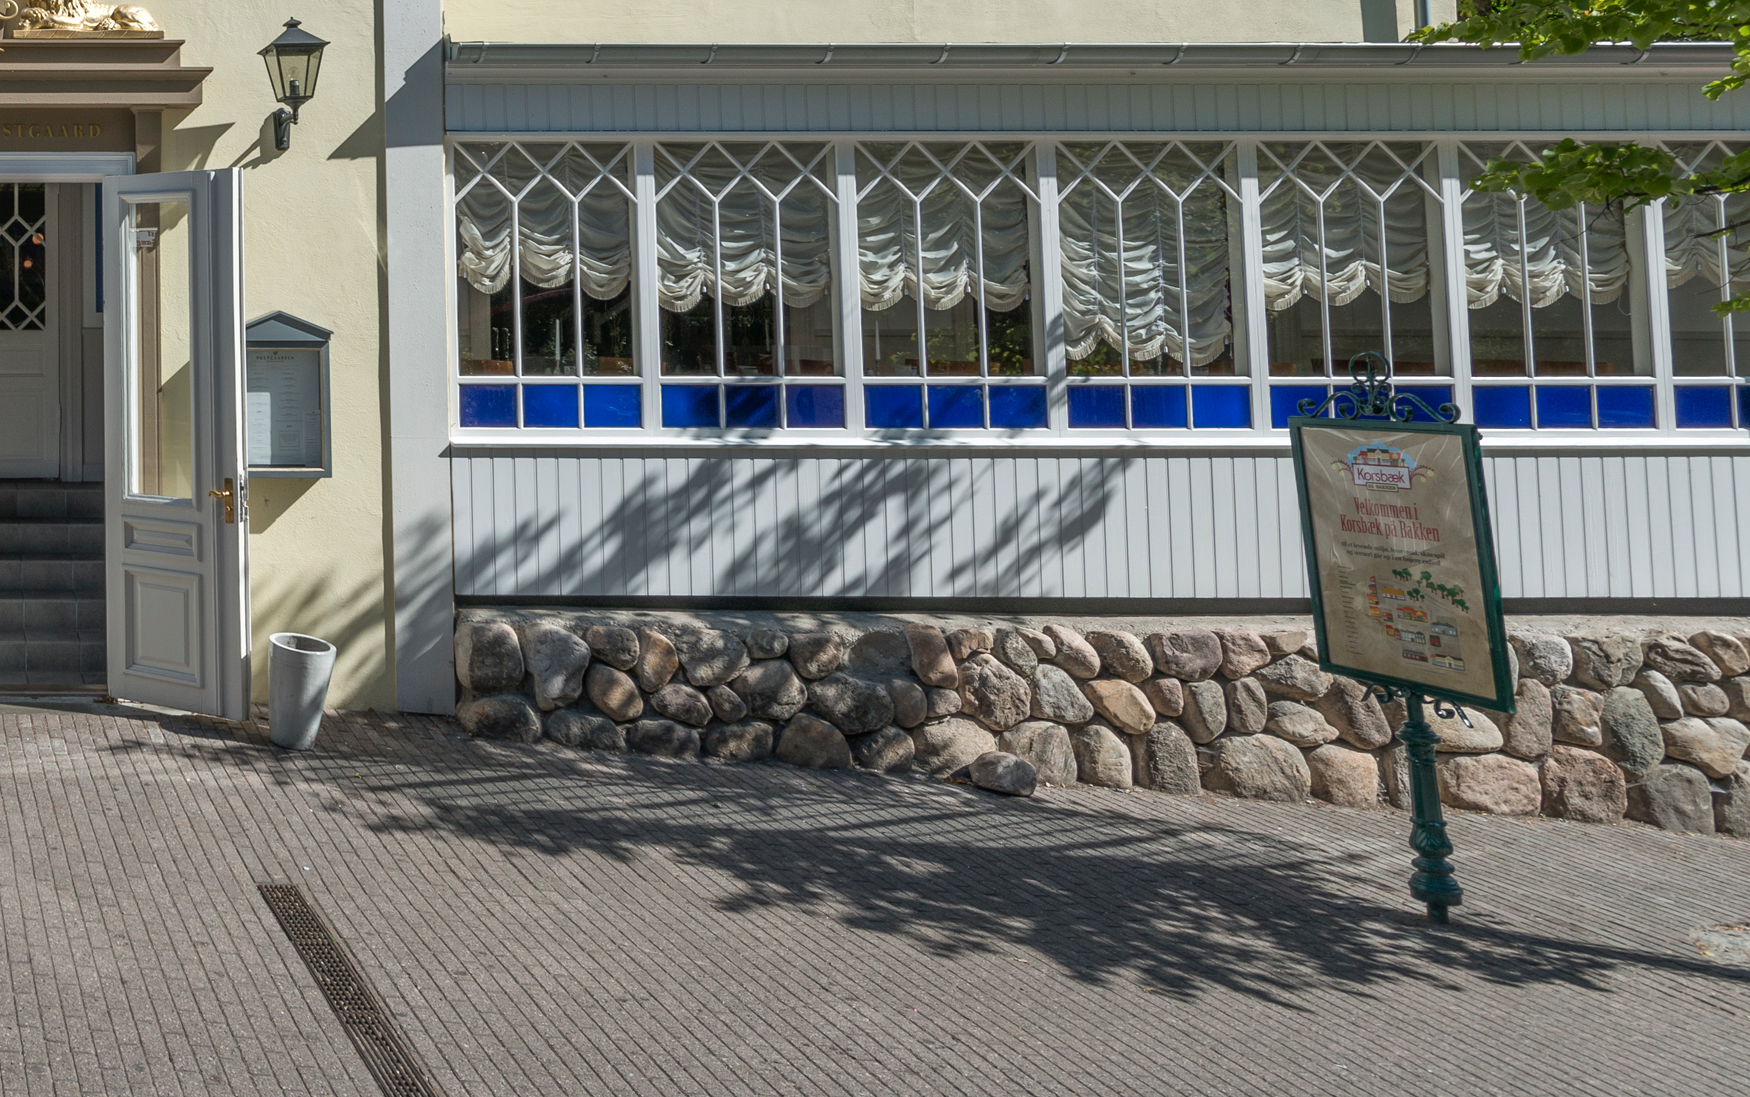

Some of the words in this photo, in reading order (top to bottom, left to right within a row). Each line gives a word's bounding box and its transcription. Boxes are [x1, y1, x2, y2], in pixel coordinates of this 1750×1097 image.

[1357, 467, 1405, 483] Korsbæk
[1353, 497, 1412, 519] Velkommen
[1413, 502, 1419, 520] i
[1340, 514, 1383, 536] Korsbæk
[1384, 520, 1398, 539] på
[1399, 520, 1440, 542] Bakken
